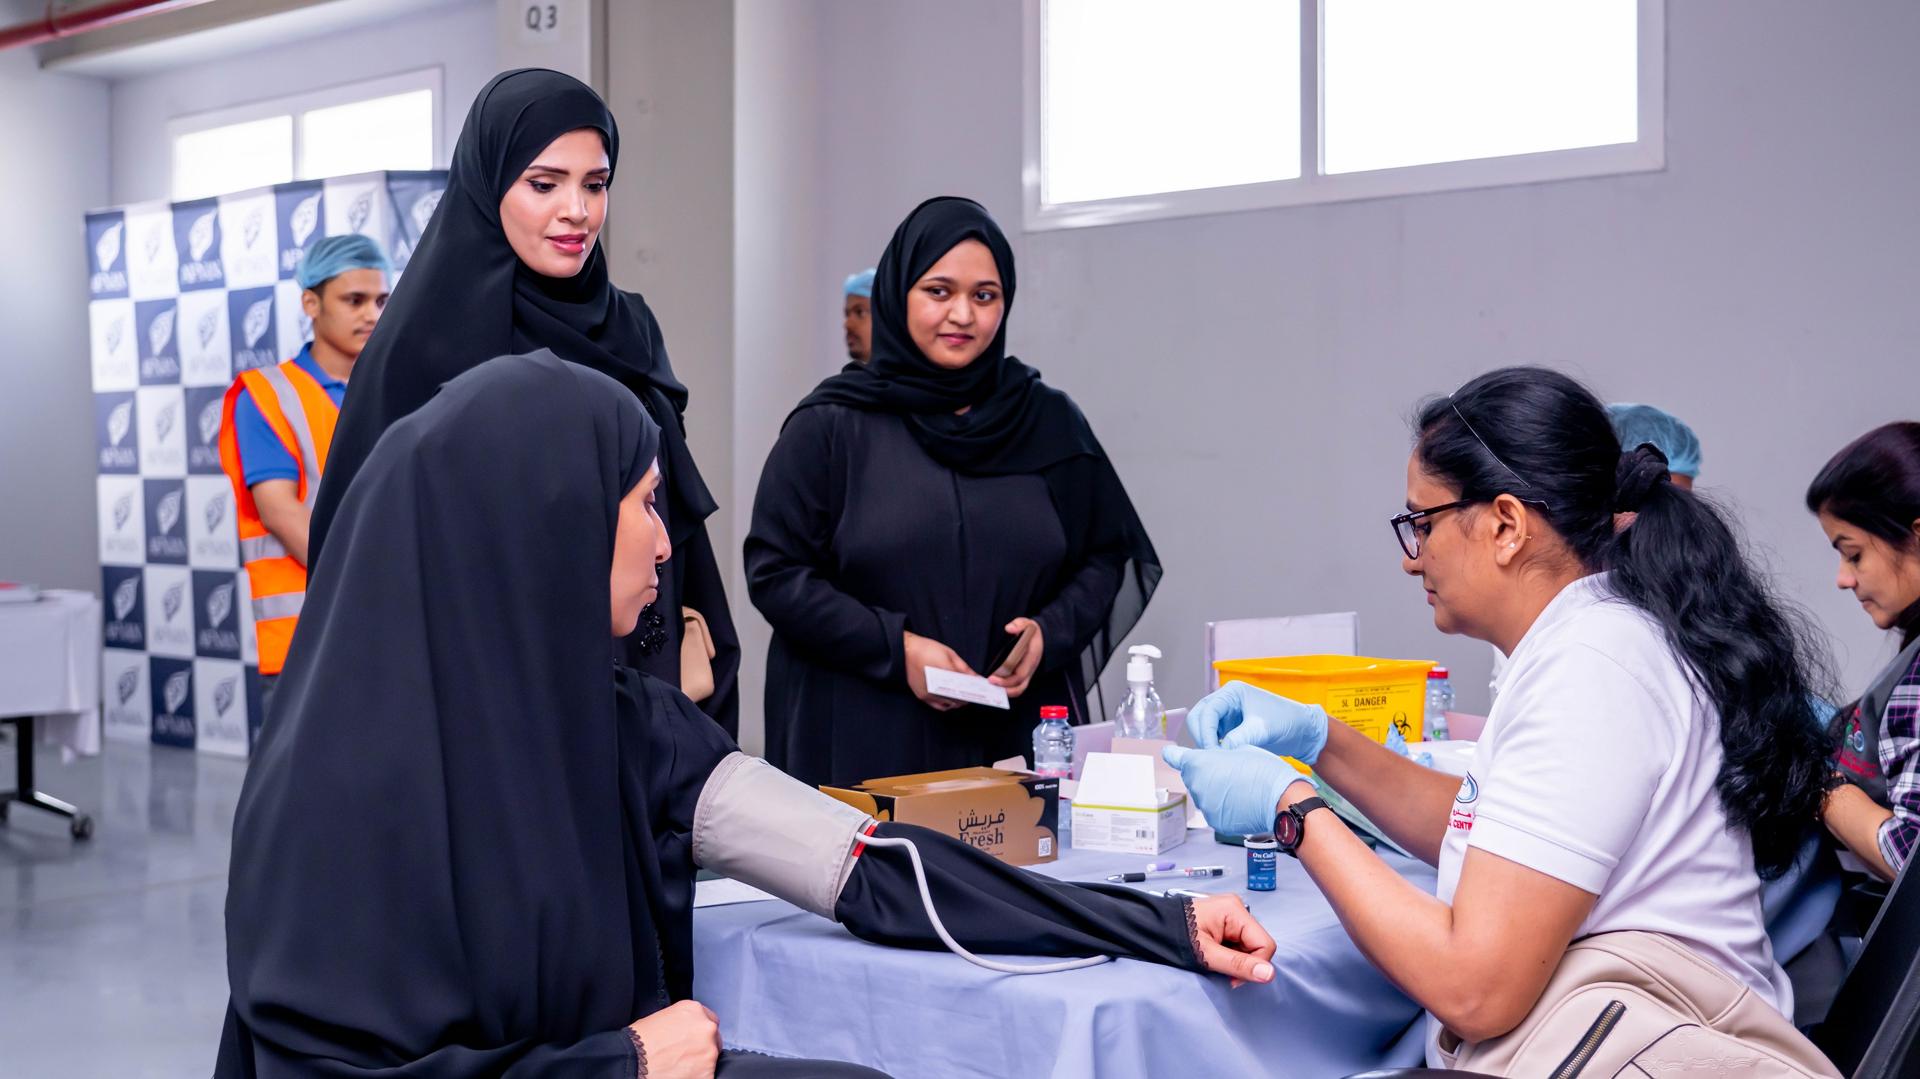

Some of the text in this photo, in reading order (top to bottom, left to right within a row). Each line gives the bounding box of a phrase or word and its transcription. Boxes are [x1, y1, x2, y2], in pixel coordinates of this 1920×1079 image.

[1354, 695, 1387, 708] DANGER
[958, 809, 1005, 832] فريش
[958, 828, 1004, 848] Fresh
